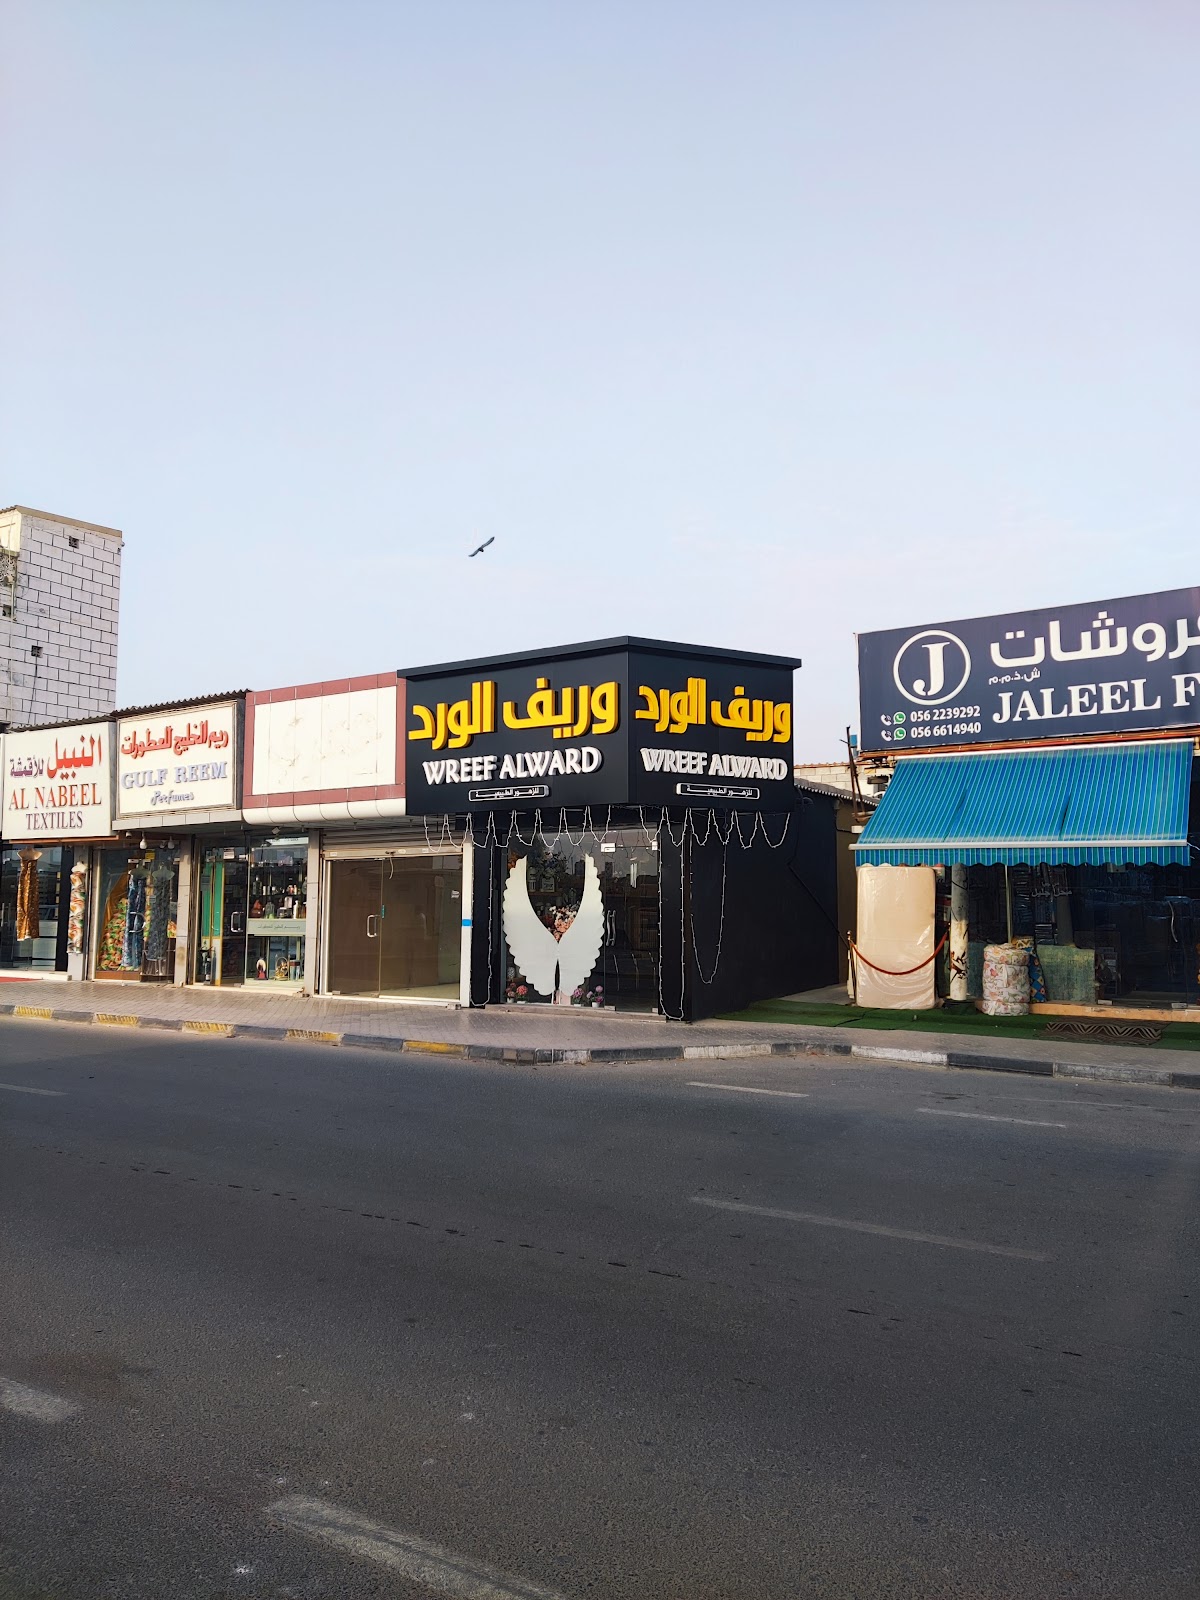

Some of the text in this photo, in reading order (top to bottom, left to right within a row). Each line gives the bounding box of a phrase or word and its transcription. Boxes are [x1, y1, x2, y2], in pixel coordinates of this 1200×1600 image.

[912, 641, 951, 696] J
[408, 677, 620, 750] وريف الورد
[635, 676, 791, 743] وريف الورد
[910, 705, 981, 723] 056 2239292
[992, 678, 1161, 723] JALEEL
[121, 720, 229, 759] ريم الخليج للعطورات
[910, 722, 982, 739] 056 6614940
[47, 733, 102, 780] النبيل
[422, 746, 603, 786] WREEF ALWARD
[639, 747, 788, 781] WREEF ALWARD
[121, 761, 228, 789] GULF REEM
[9, 783, 102, 811] AL NABEEL
[150, 790, 195, 806] Perfumes
[25, 810, 83, 830] TEXTILES
